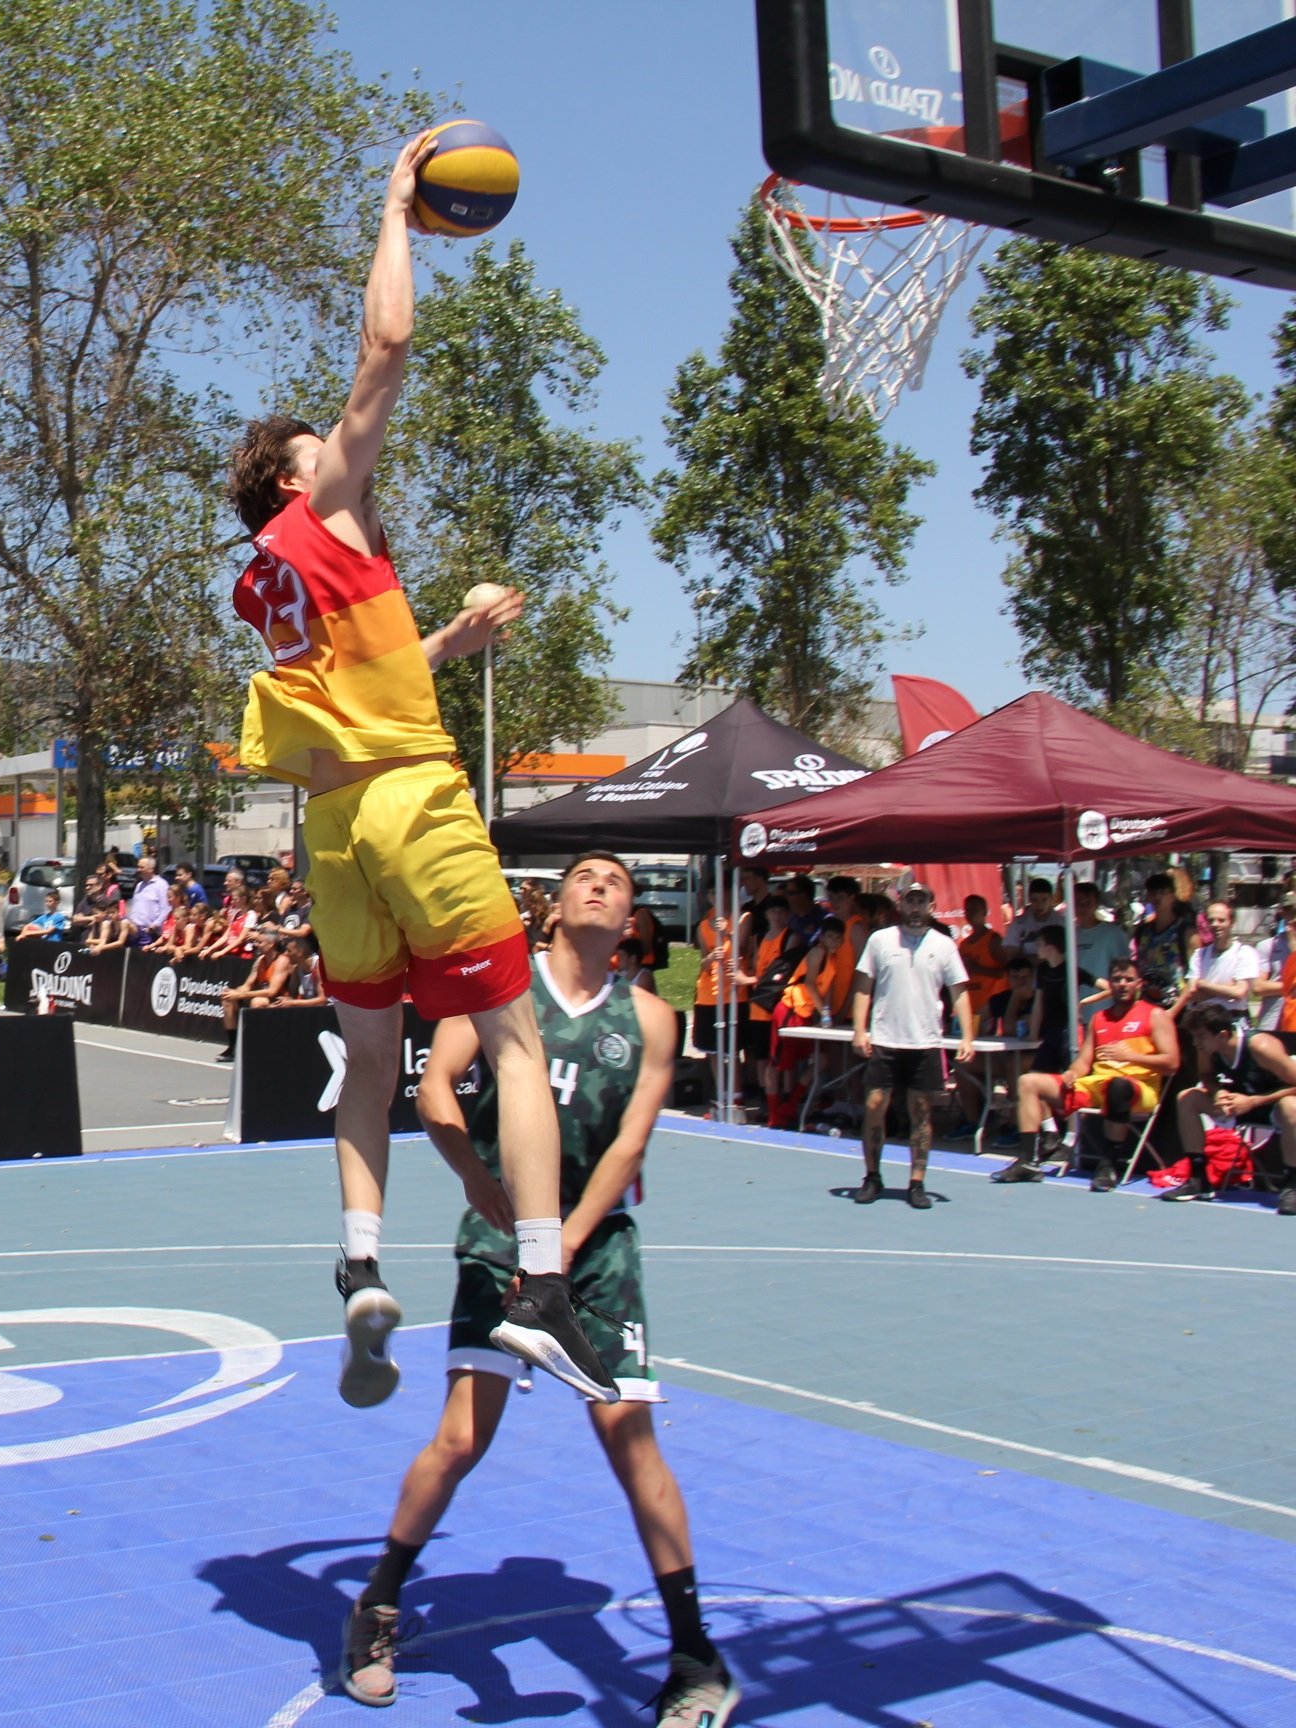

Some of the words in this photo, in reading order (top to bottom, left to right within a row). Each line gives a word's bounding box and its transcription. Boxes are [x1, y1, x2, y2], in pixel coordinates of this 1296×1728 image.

[750, 769, 873, 791] SPALDIN
[176, 997, 225, 1018] Barcelona
[404, 1037, 432, 1075] la
[549, 1058, 580, 1106] 4
